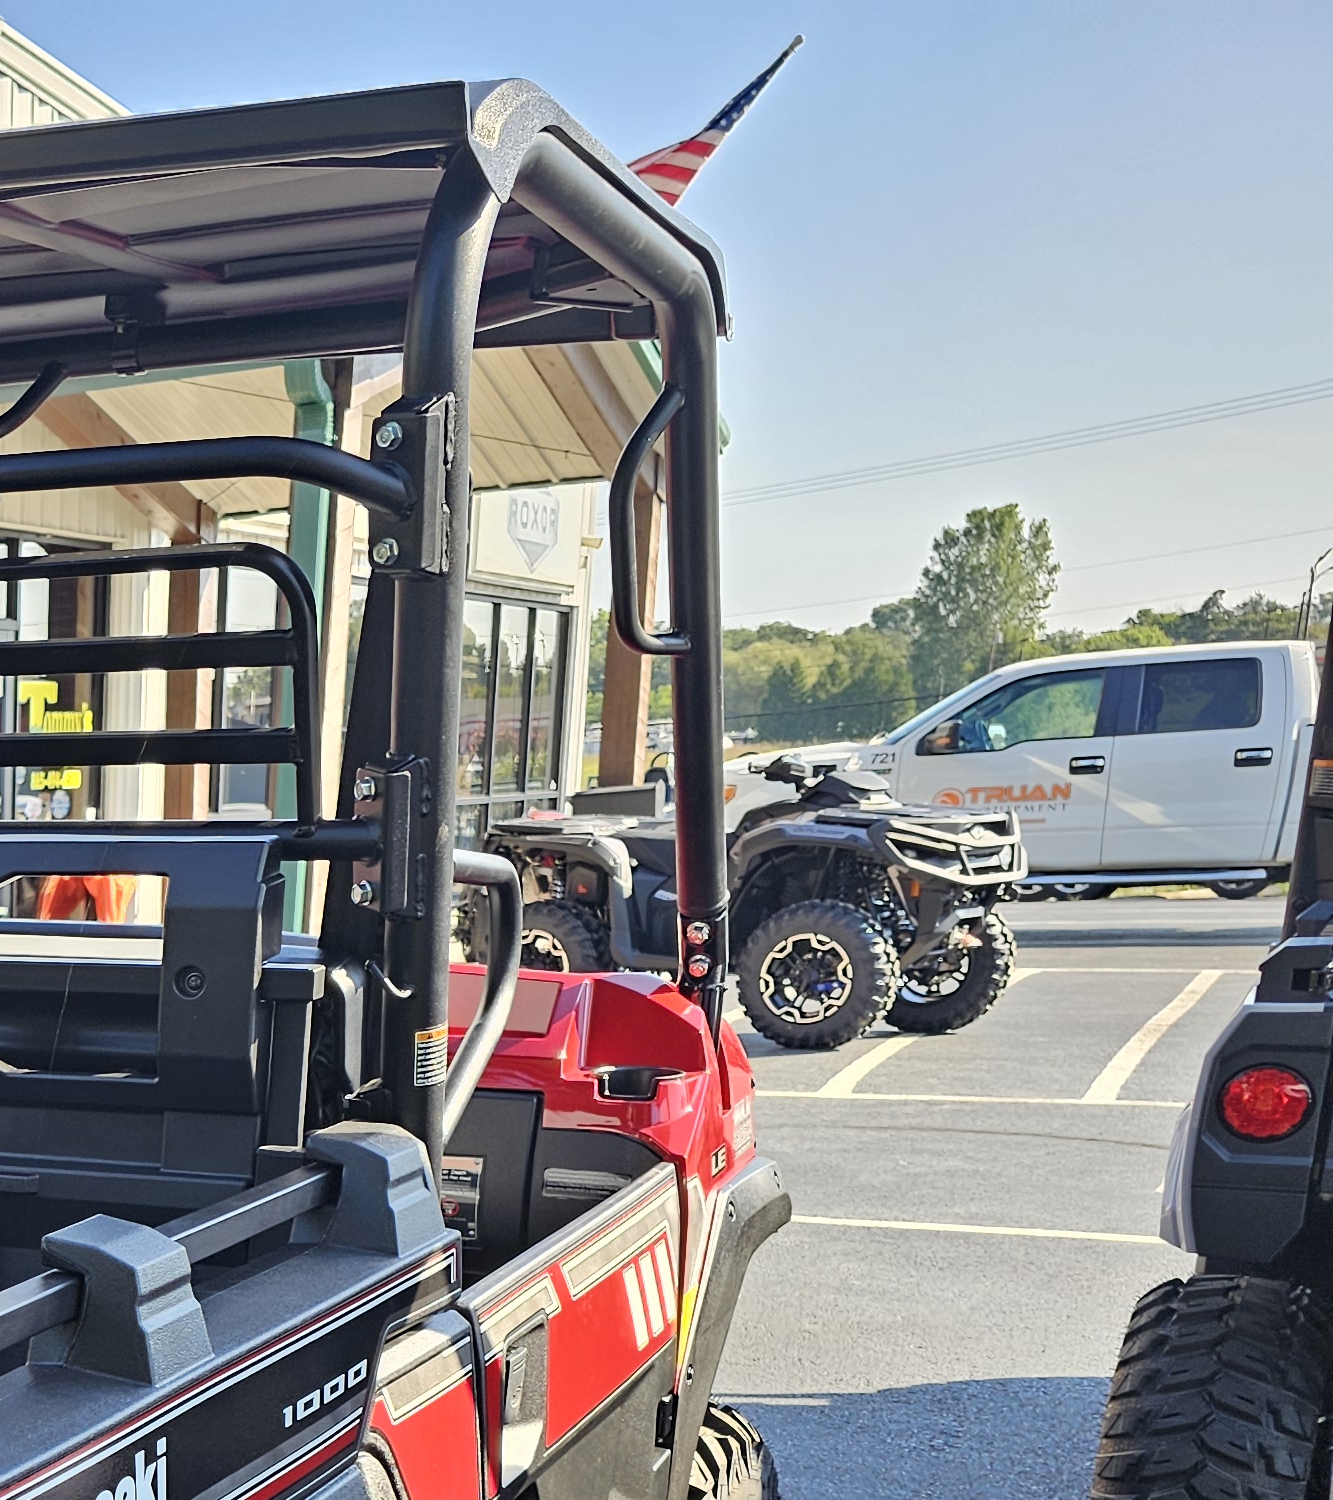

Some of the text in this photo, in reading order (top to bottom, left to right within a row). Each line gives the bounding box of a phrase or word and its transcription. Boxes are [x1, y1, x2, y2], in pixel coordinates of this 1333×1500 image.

[509, 497, 556, 534] ROXOR
[871, 752, 895, 765] 721
[965, 782, 1072, 804] TRUAN
[985, 803, 1068, 815] UIPMENT
[711, 1144, 727, 1179] LE
[283, 1358, 367, 1428] 1000
